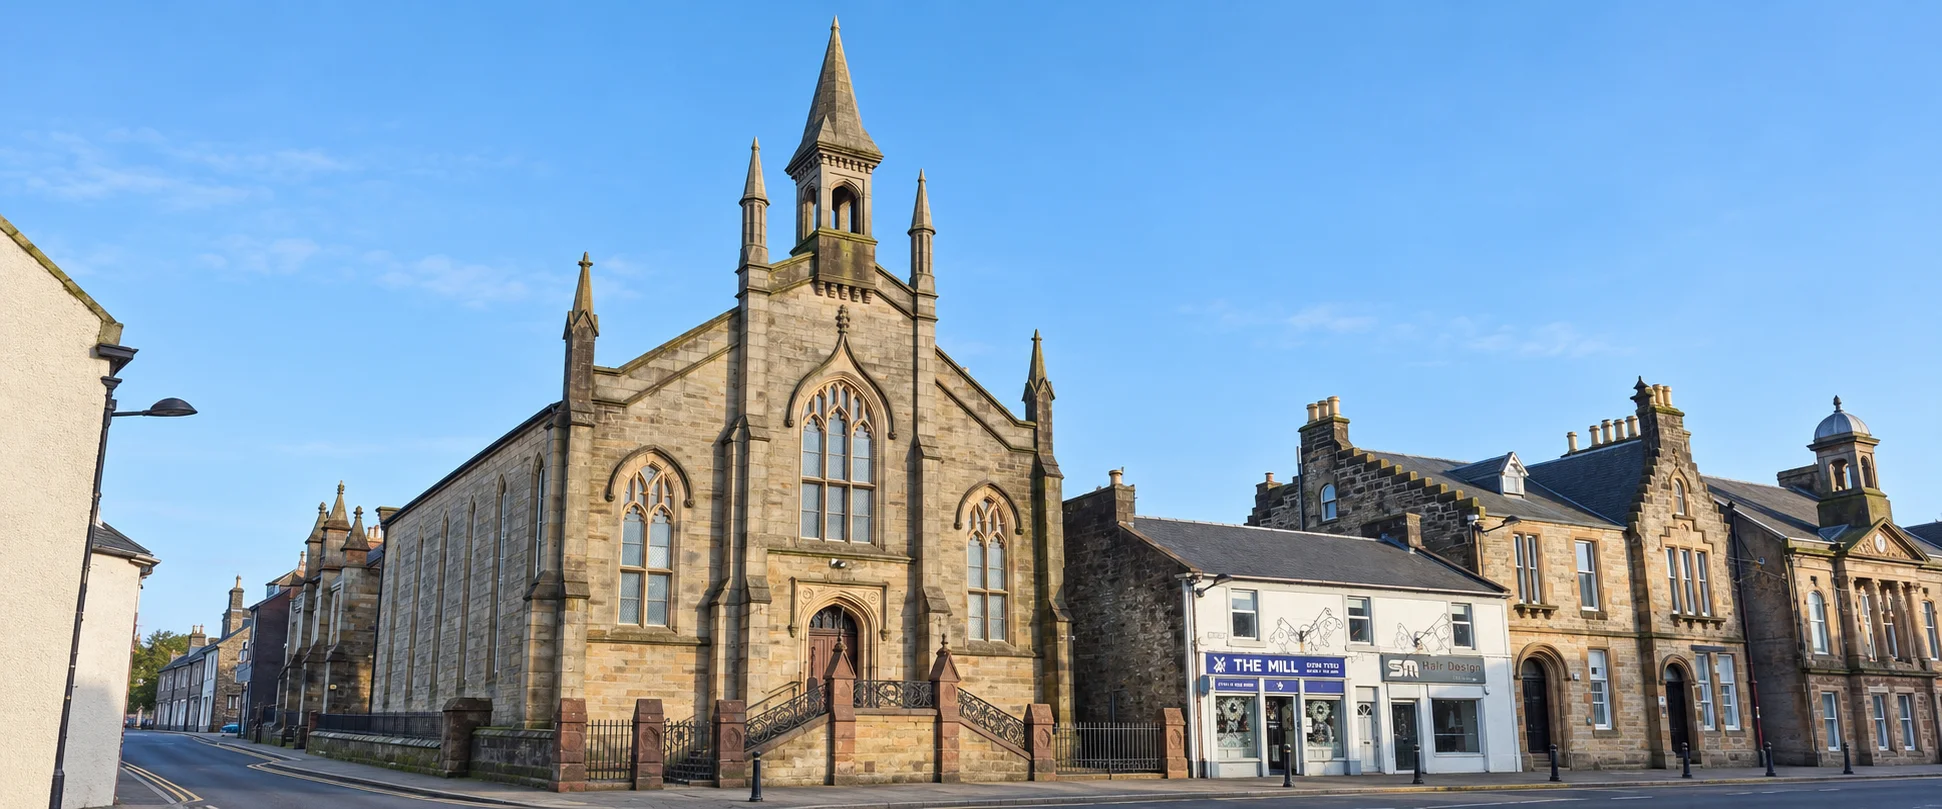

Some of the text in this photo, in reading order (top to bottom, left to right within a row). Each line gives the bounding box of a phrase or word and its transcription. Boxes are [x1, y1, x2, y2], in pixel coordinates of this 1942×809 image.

[1233, 658, 1262, 672] THE
[1268, 660, 1299, 673] MILL
[1422, 661, 1443, 671] Hair
